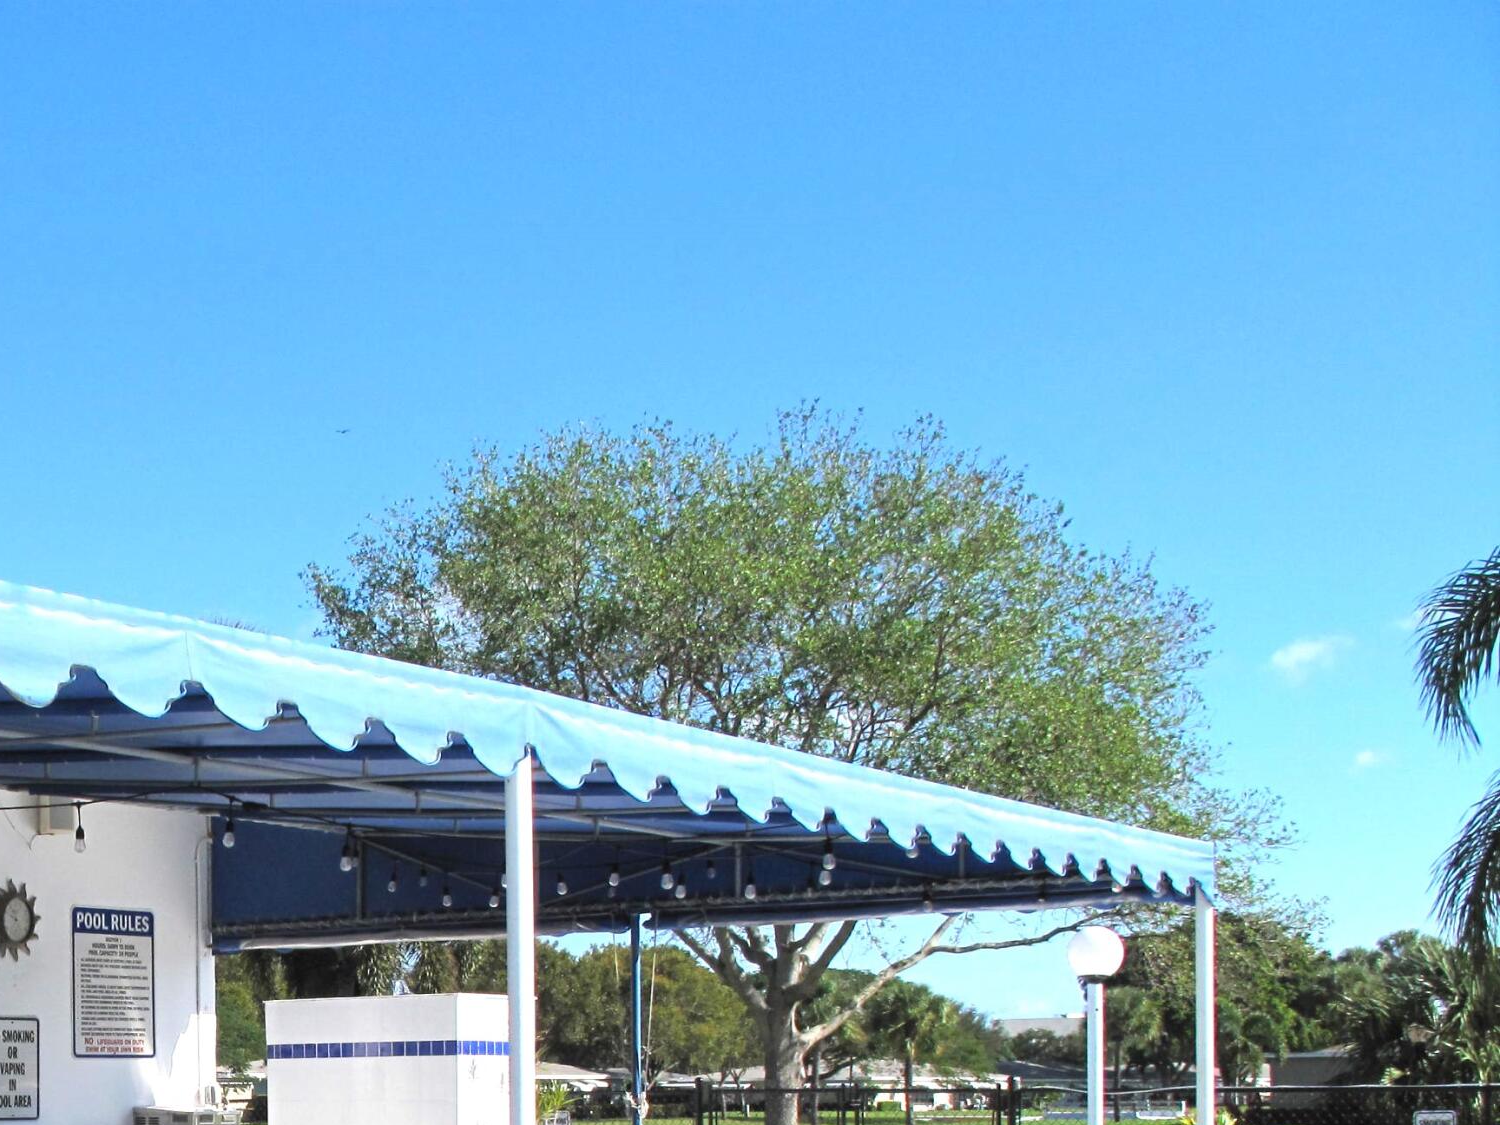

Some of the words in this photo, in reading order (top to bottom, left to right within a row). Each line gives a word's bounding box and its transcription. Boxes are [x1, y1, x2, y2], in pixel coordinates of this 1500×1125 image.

[76, 912, 109, 930] POOL
[111, 914, 150, 933] RULES
[2, 1030, 35, 1043] SMOKING
[84, 1037, 93, 1045] NO
[7, 1046, 18, 1059] OR
[0, 1062, 26, 1075] VAPING
[9, 1079, 17, 1091] IN
[13, 1095, 32, 1108] AREA
